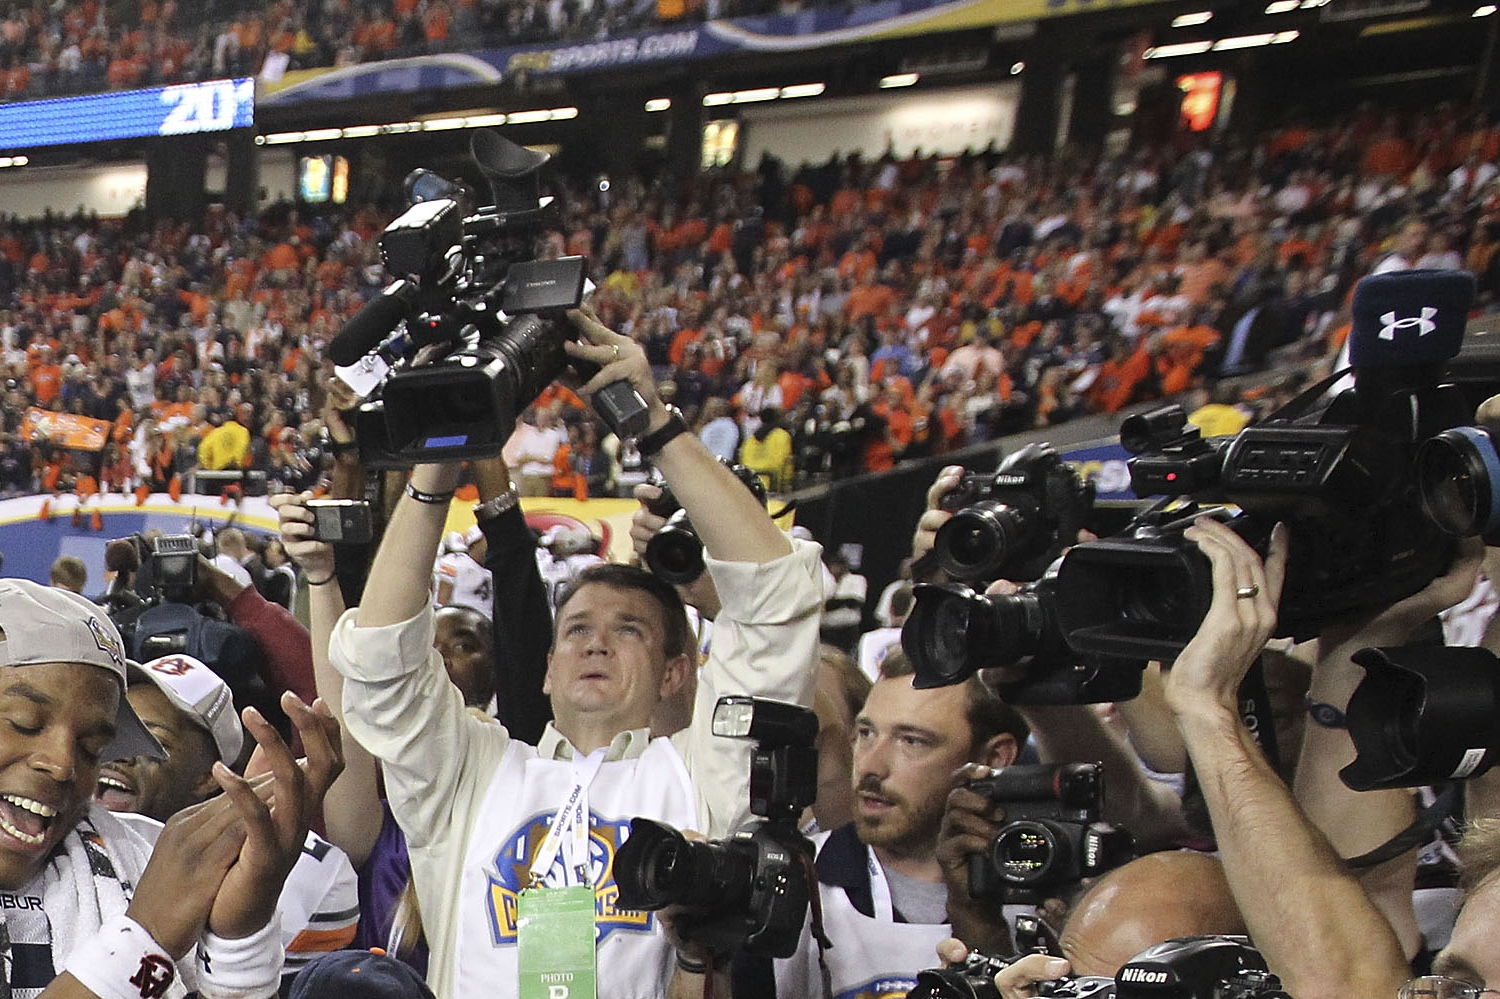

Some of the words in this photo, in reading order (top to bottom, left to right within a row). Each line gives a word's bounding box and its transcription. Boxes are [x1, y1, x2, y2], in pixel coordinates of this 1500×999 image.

[996, 474, 1025, 487] Nikon
[1087, 834, 1097, 868] Nikon
[541, 972, 574, 983] PHOTO
[1121, 967, 1168, 984] Nikon
